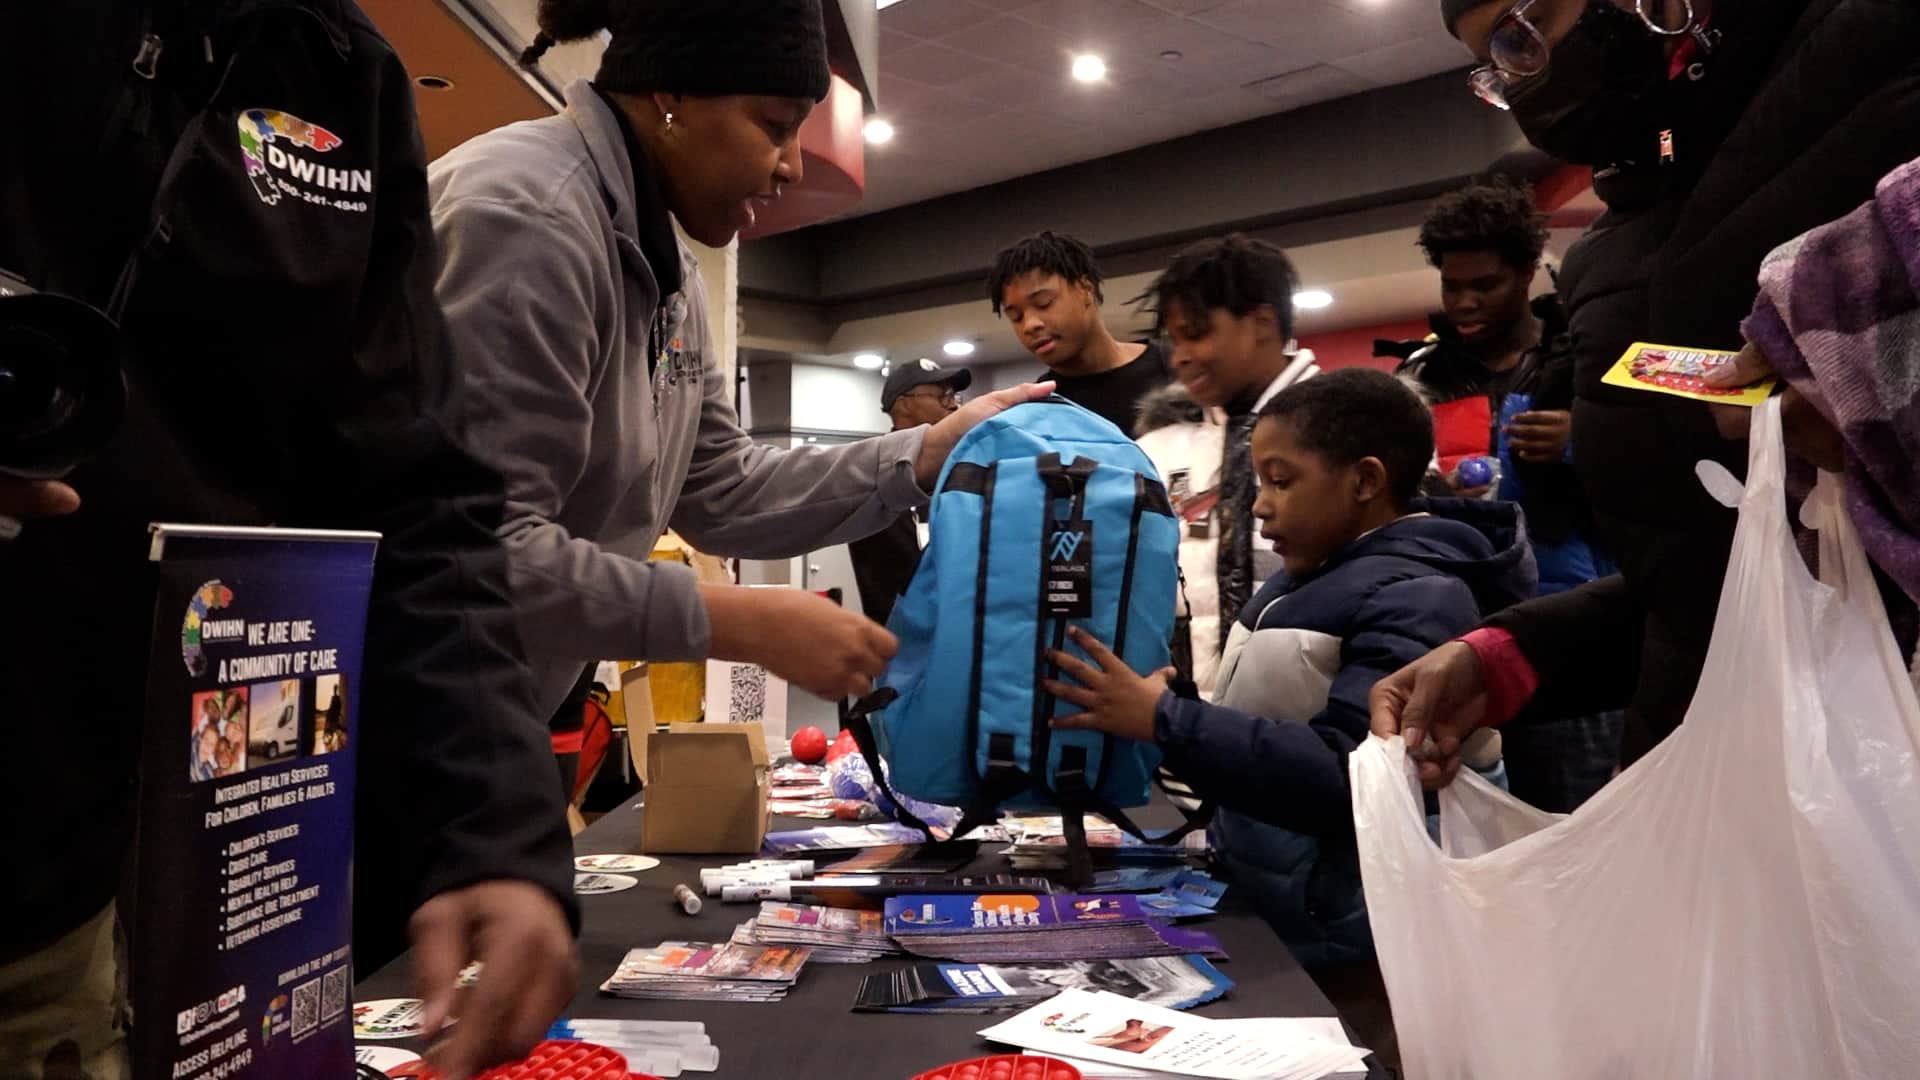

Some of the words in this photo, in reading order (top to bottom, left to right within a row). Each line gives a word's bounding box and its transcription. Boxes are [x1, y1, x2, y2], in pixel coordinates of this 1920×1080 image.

[267, 144, 372, 193] DWIHN
[202, 619, 245, 639] DWIHN
[248, 623, 266, 646] WE
[267, 621, 290, 644] ARE
[217, 659, 228, 684] A
[229, 652, 292, 682] COMMUNITY
[293, 651, 308, 674] OF
[310, 648, 338, 672] CARE
[204, 811, 223, 829] FOR
[250, 850, 268, 867] CARE
[173, 1049, 209, 1080] ACCESS
